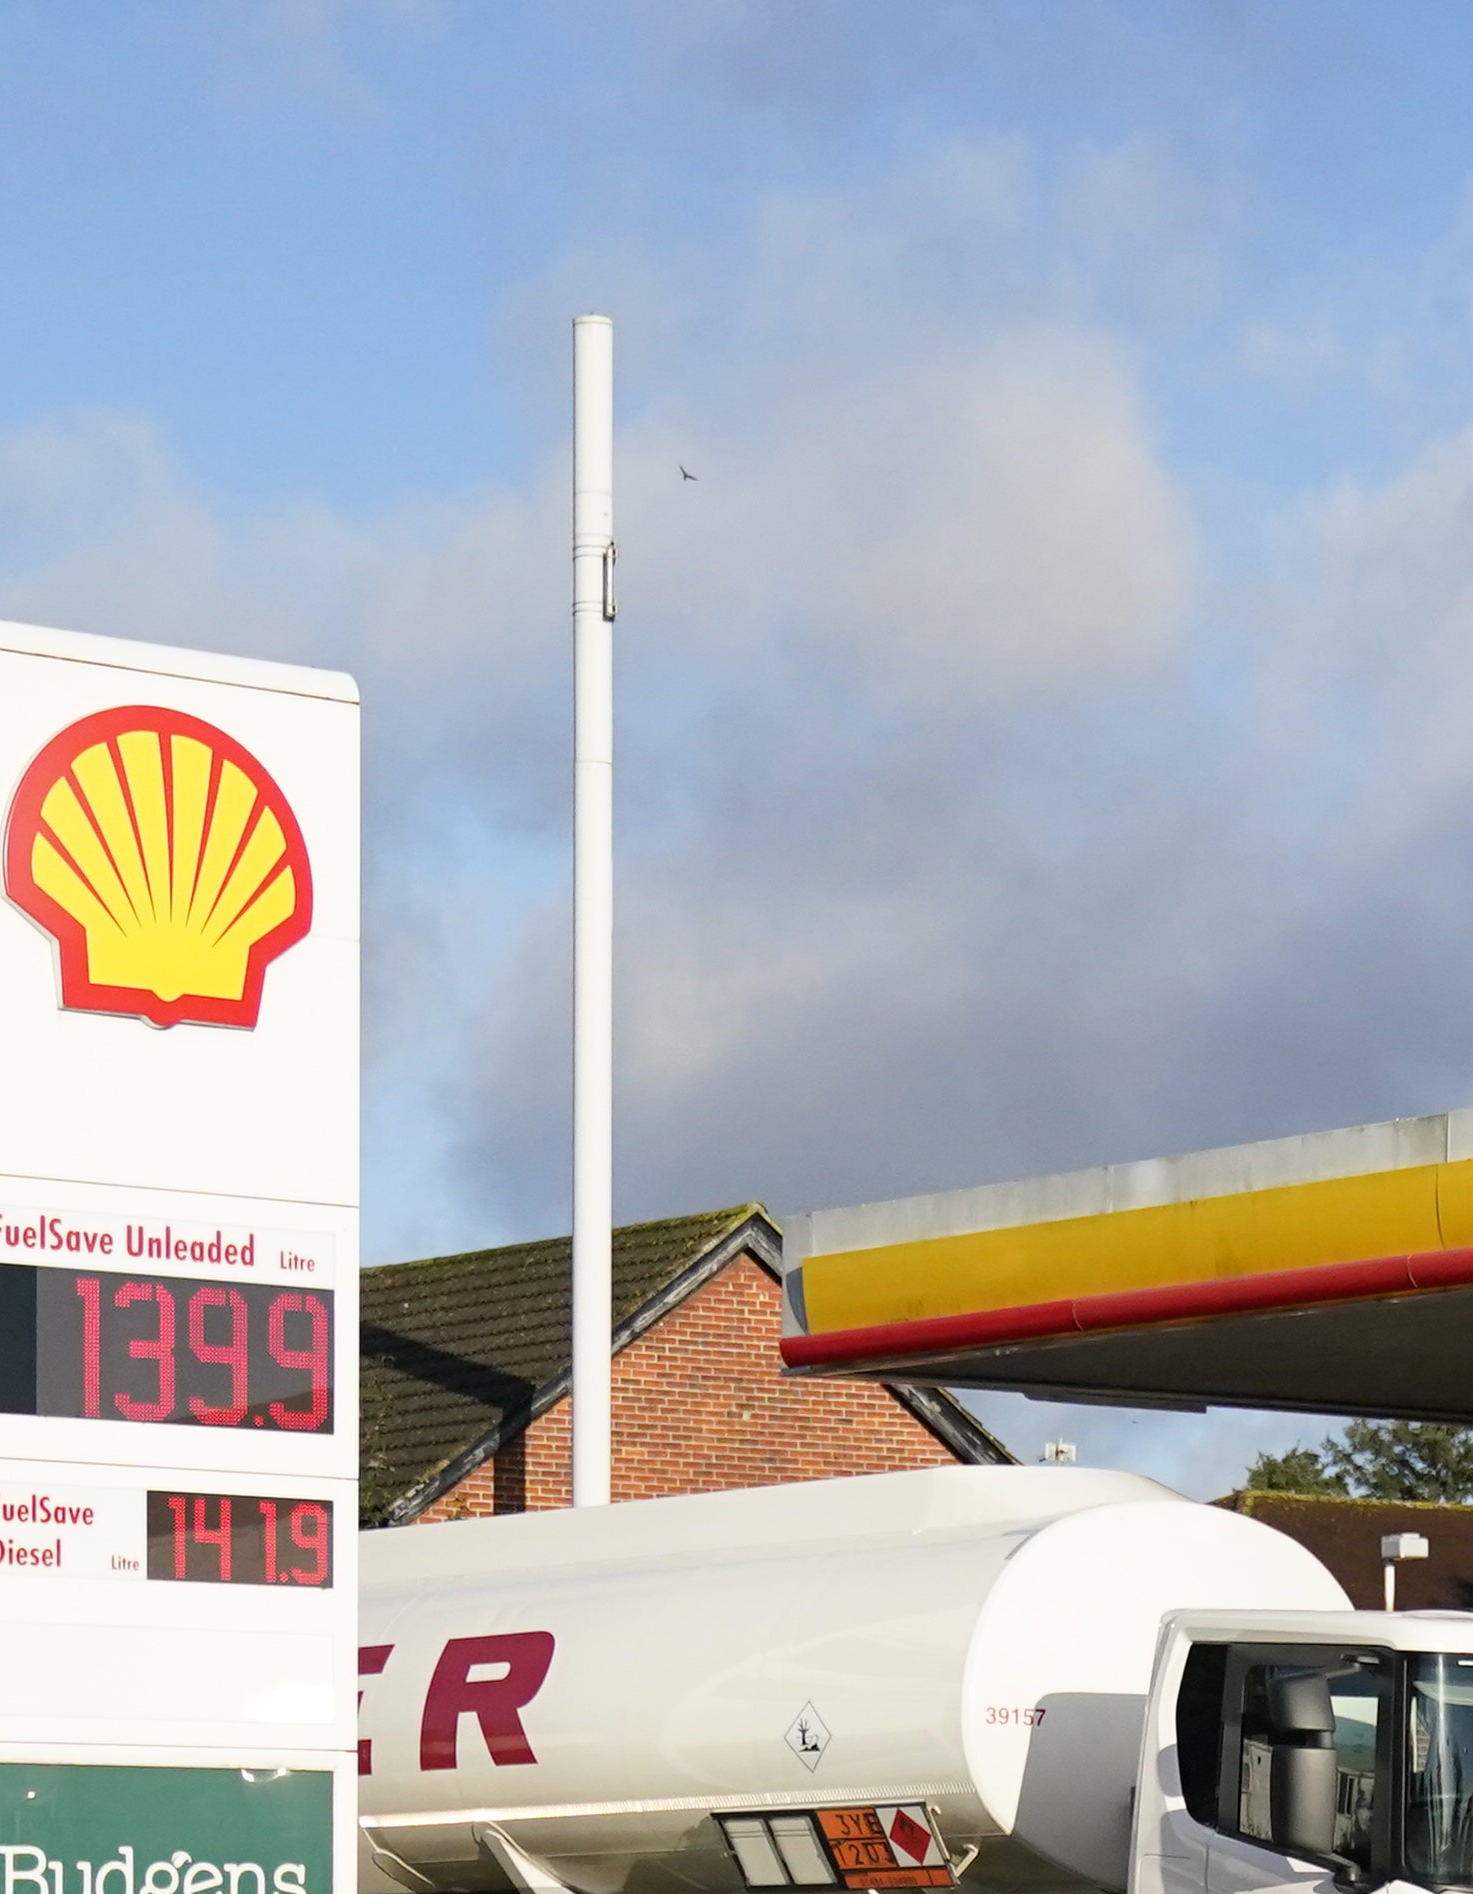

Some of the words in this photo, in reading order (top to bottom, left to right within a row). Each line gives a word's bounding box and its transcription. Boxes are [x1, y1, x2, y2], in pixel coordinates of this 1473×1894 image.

[126, 1224, 256, 1267] Unleaded
[279, 1250, 316, 1273] Litre
[76, 1277, 329, 1431] 139.9
[110, 1554, 140, 1572] Litre
[985, 1706, 1047, 1728] 39157
